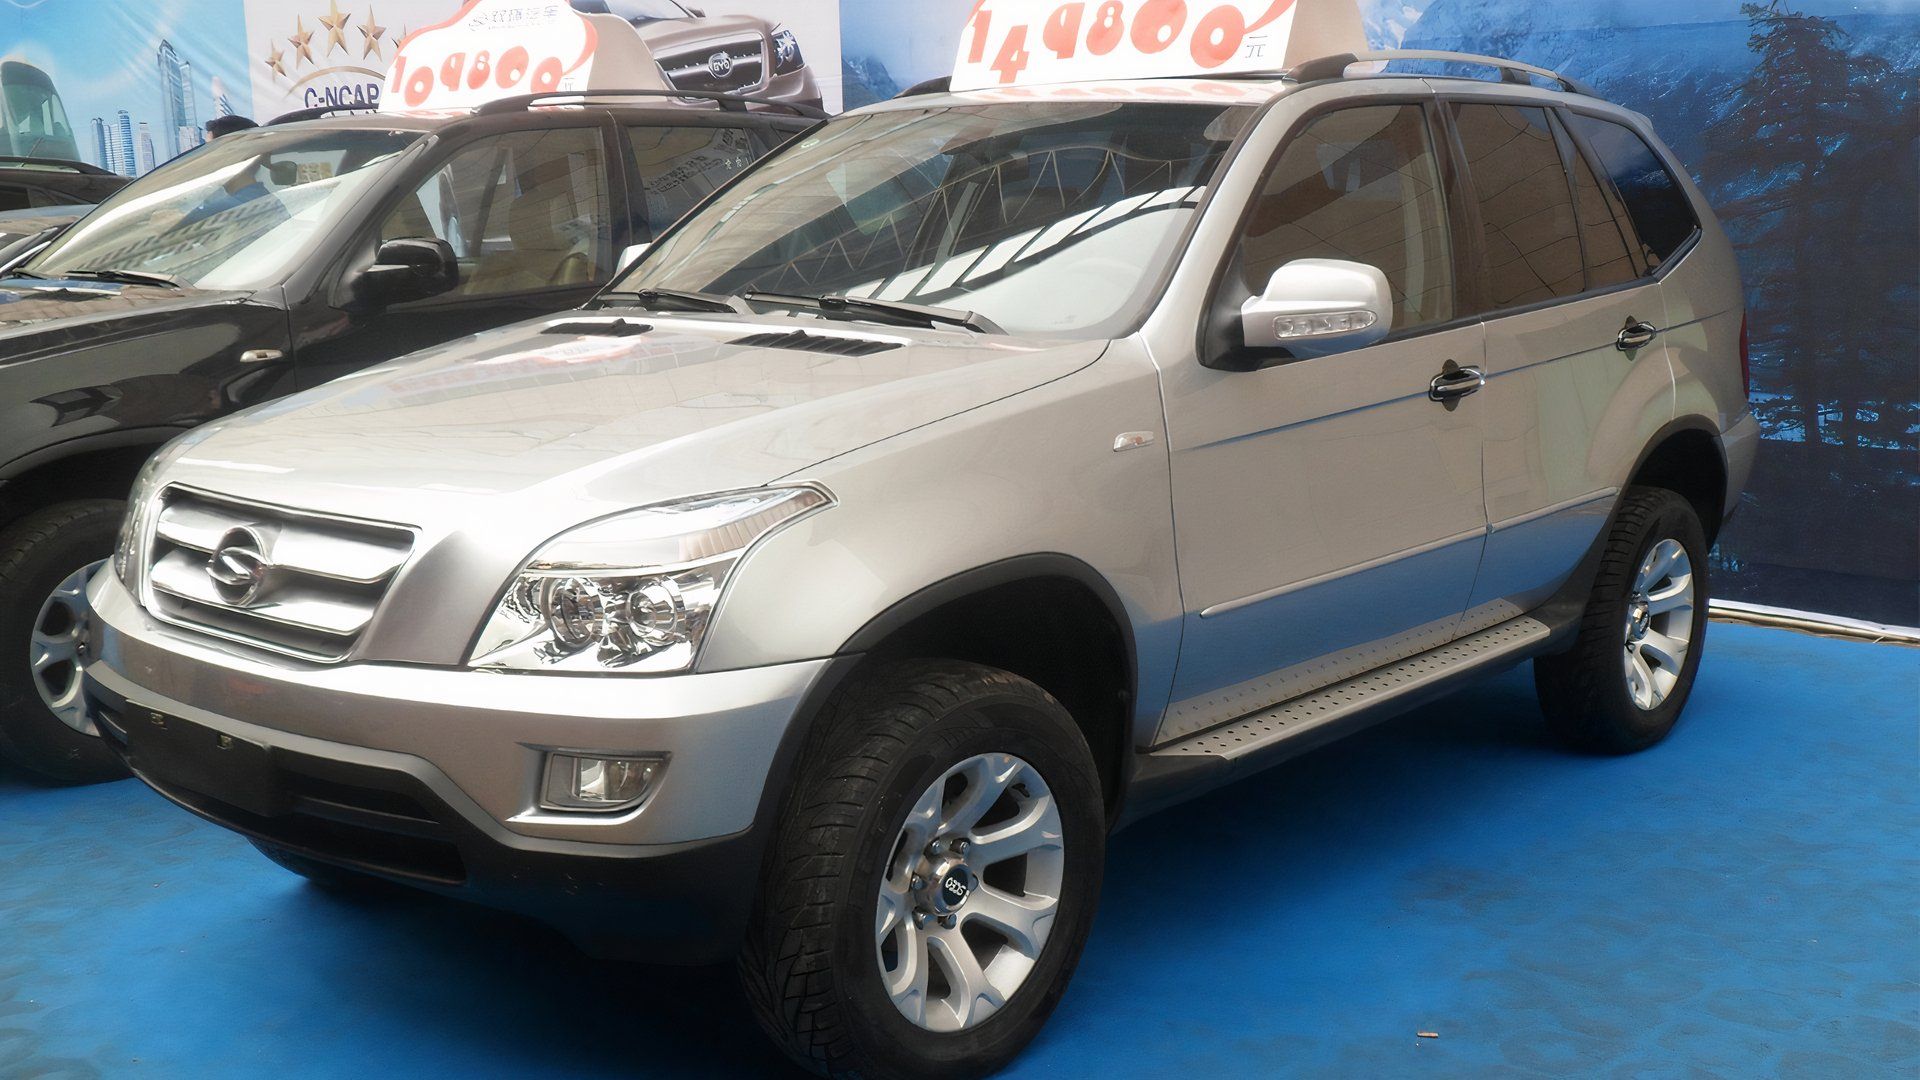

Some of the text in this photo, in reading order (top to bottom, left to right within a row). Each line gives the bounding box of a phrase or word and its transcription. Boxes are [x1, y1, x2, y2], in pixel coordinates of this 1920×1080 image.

[968, 0, 1246, 84] 149800
[304, 83, 380, 108] C-NCAP
[390, 45, 564, 107] 109800
